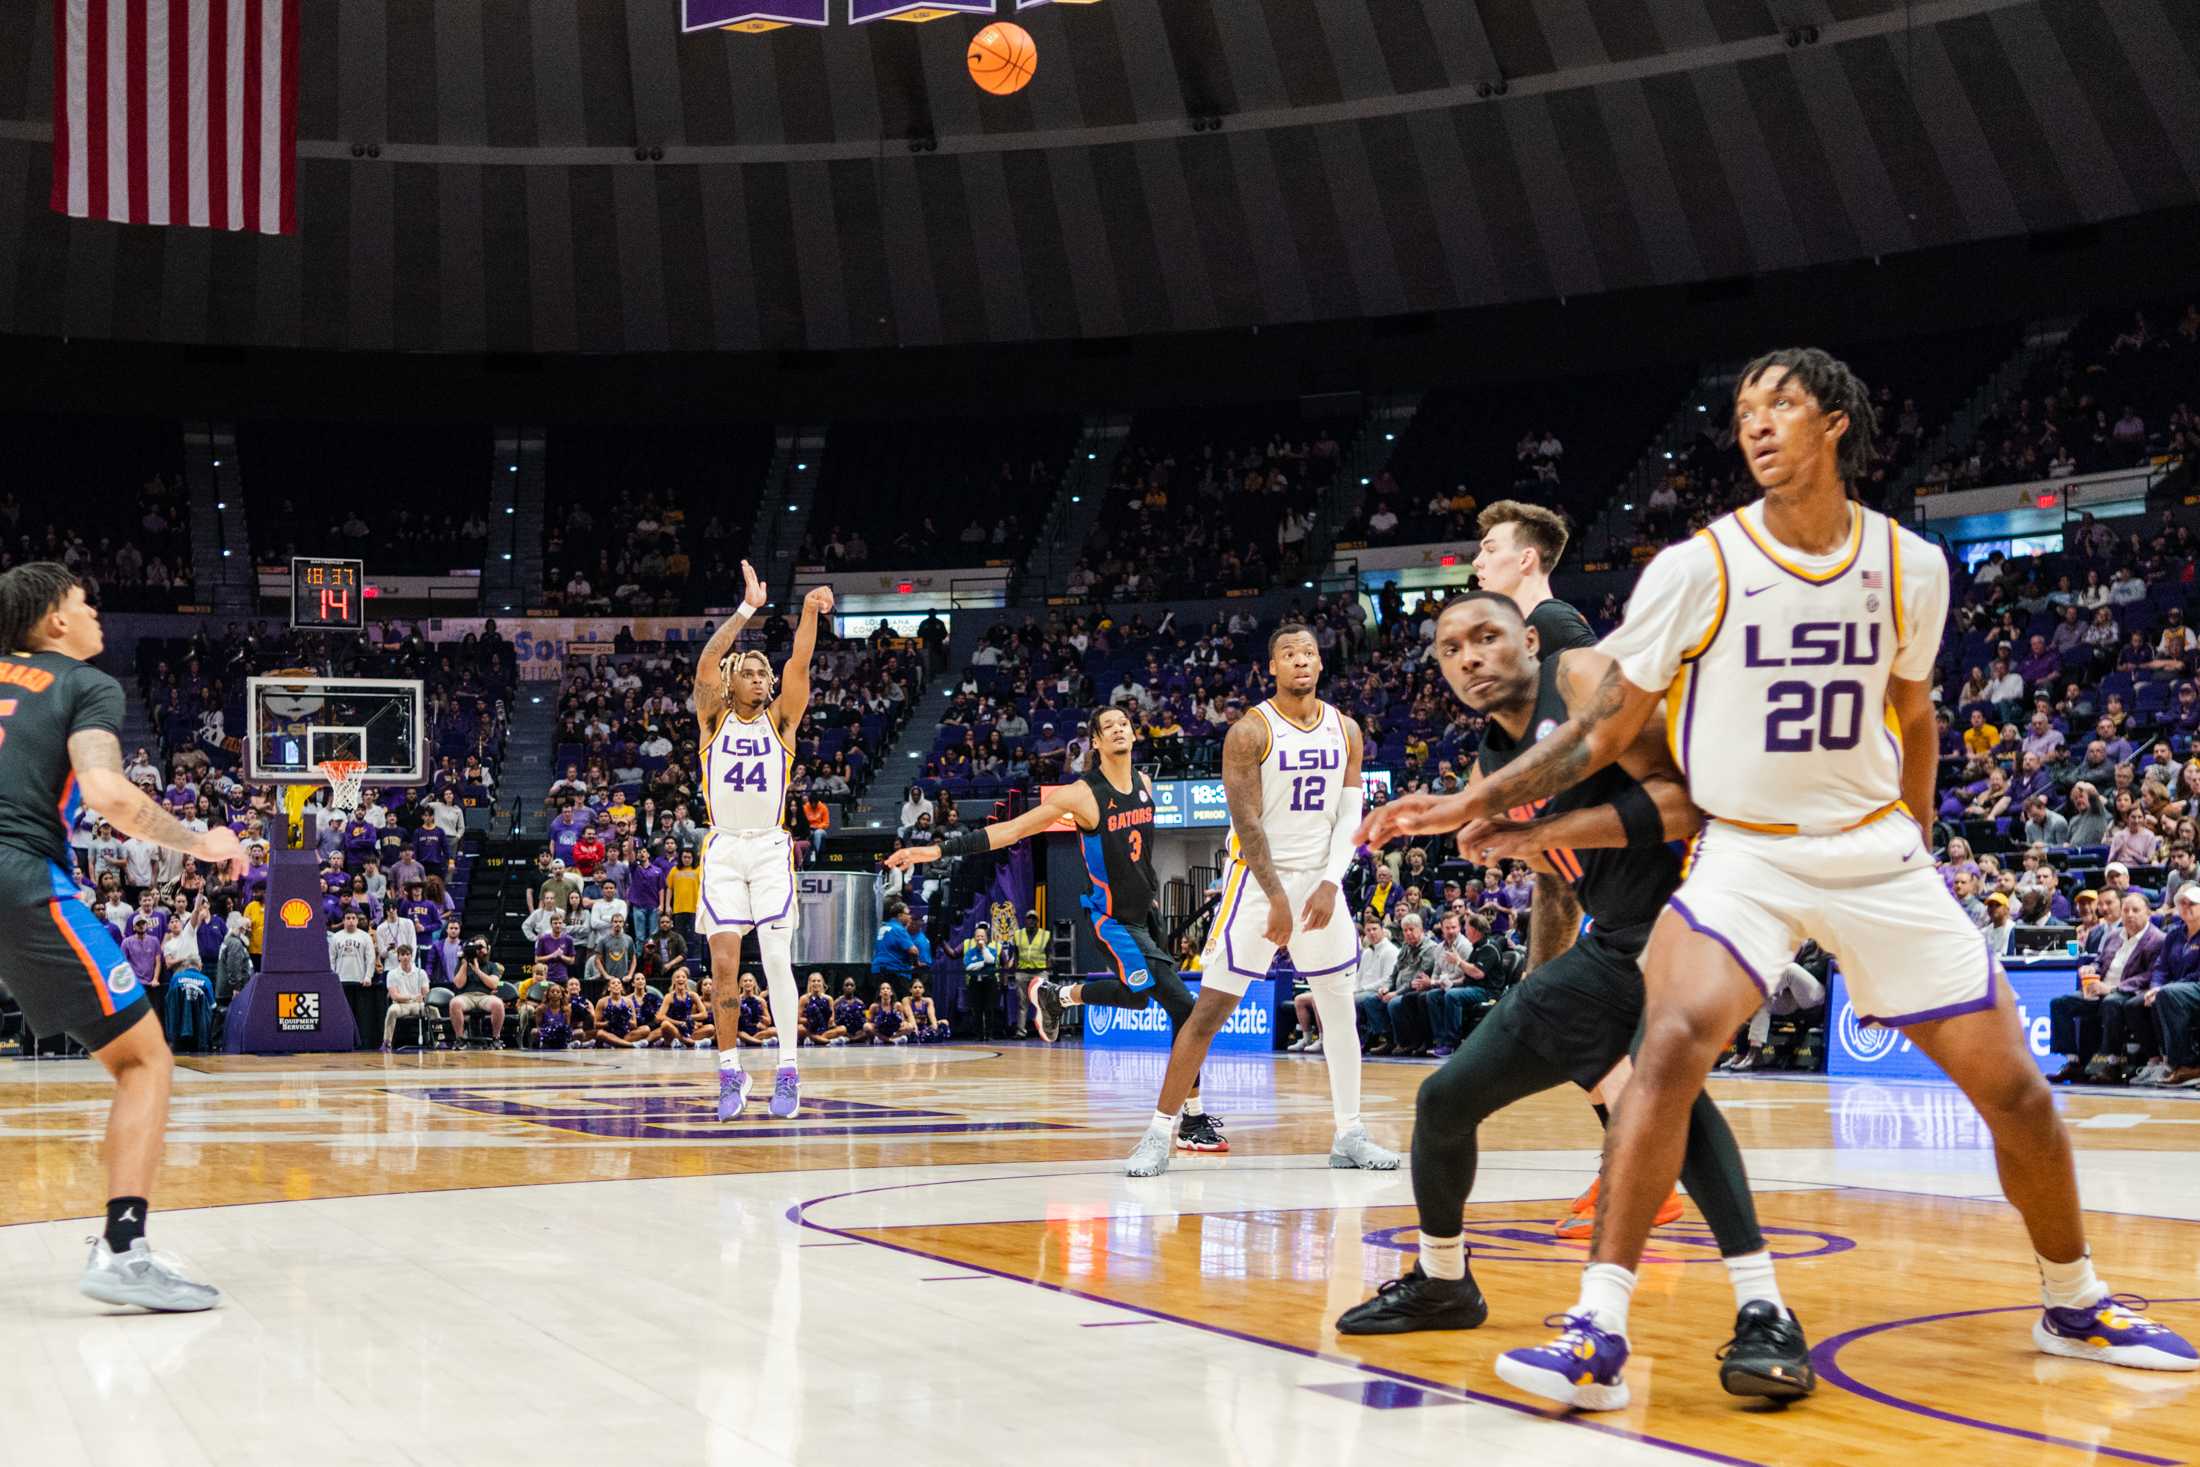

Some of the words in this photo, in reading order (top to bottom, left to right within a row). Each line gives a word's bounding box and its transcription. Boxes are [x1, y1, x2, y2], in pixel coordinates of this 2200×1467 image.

[321, 589, 348, 619] 14
[1745, 622, 1880, 667] LSU
[1764, 680, 1863, 752] 20
[722, 735, 771, 757] LSU
[1279, 749, 1339, 771] LSU
[723, 762, 767, 792] 44
[1162, 792, 1172, 804] 0
[1191, 785, 1227, 805] 18:3
[1289, 776, 1326, 811] 12
[1107, 807, 1153, 832] GATORS
[1193, 810, 1226, 821] PERIOD
[1128, 830, 1143, 863] 3
[796, 879, 832, 894] SU
[408, 907, 428, 915] LSU
[279, 993, 319, 1018] K&E
[1111, 1000, 1166, 1031] Allstate
[1218, 1002, 1268, 1034] state
